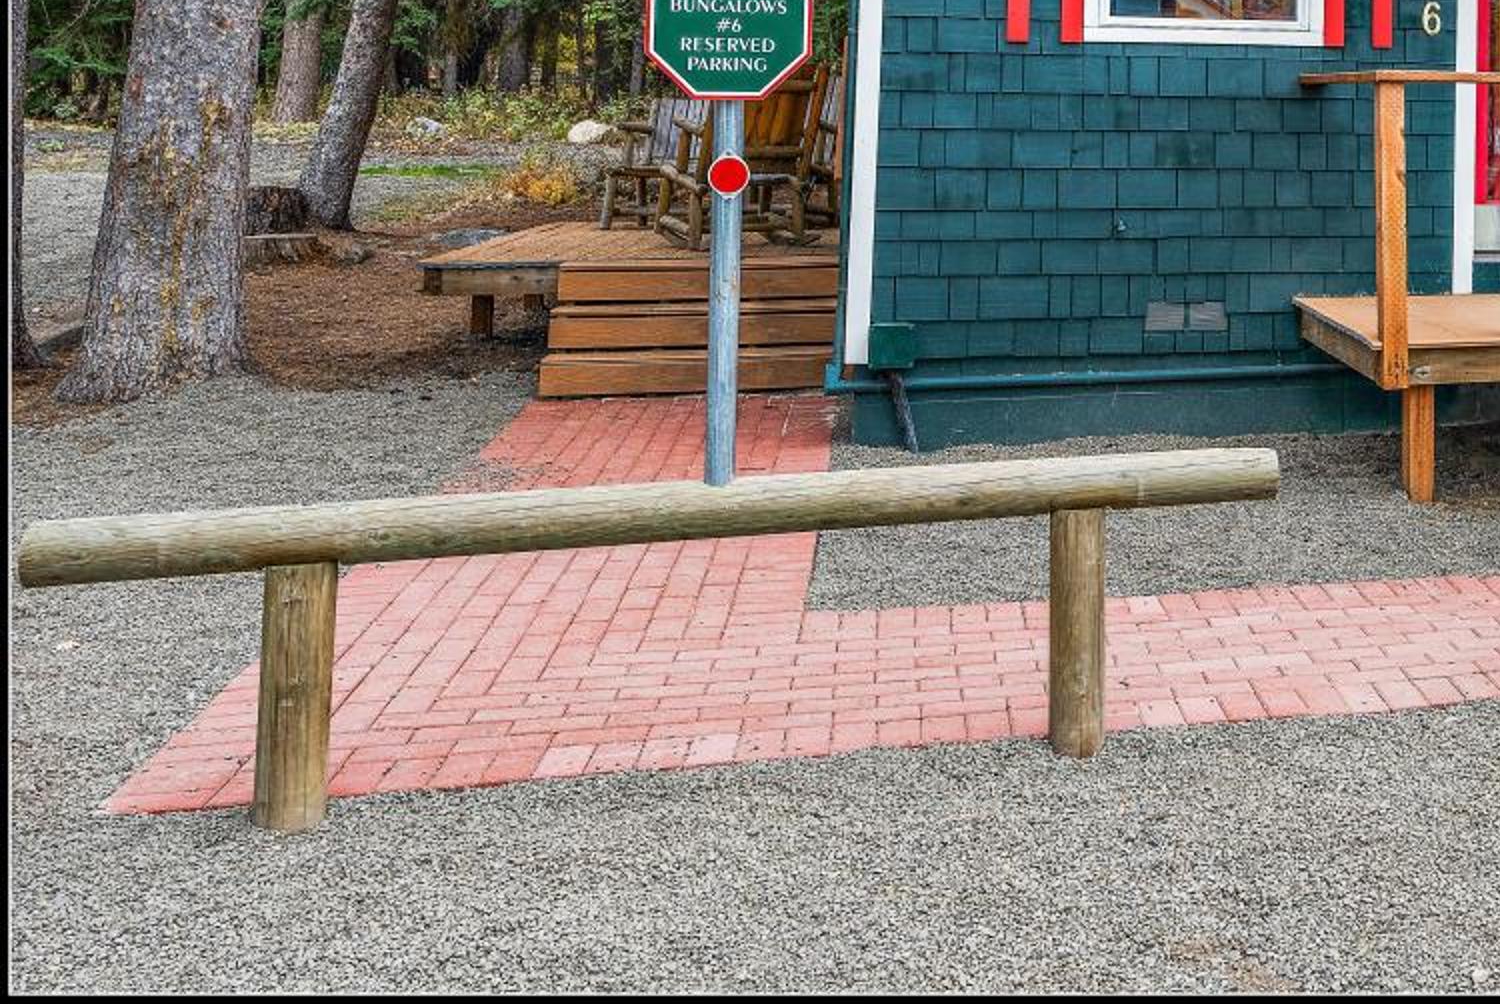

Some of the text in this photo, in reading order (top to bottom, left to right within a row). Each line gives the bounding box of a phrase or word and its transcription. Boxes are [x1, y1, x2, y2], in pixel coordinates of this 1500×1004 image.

[716, 18, 742, 33] #6
[1423, 1, 1441, 36] 6
[681, 37, 776, 53] RESERVED
[687, 57, 768, 72] PARKING
